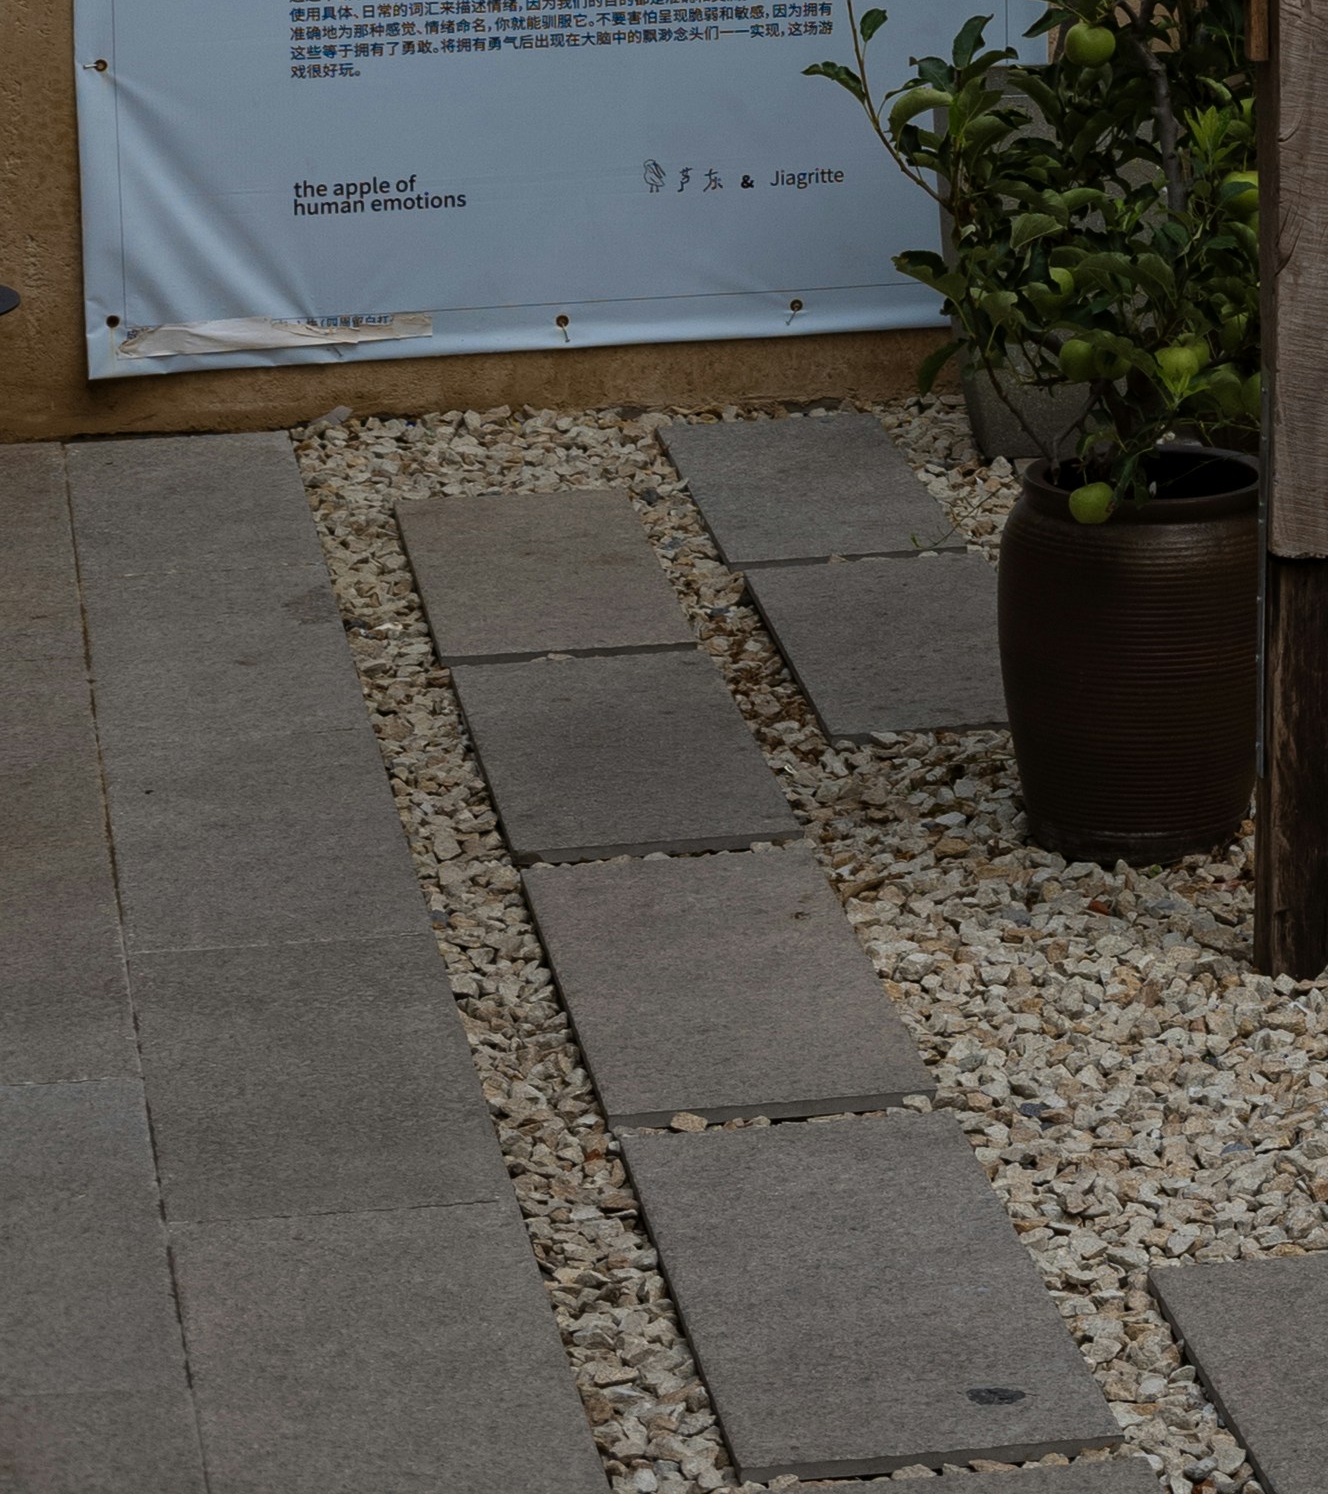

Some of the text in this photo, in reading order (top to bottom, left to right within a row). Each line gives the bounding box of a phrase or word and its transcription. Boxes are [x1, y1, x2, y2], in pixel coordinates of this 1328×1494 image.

[294, 174, 417, 199] the apple of
[740, 174, 754, 189] &
[770, 168, 845, 189] Jiagritte
[294, 192, 467, 216] human emotions
